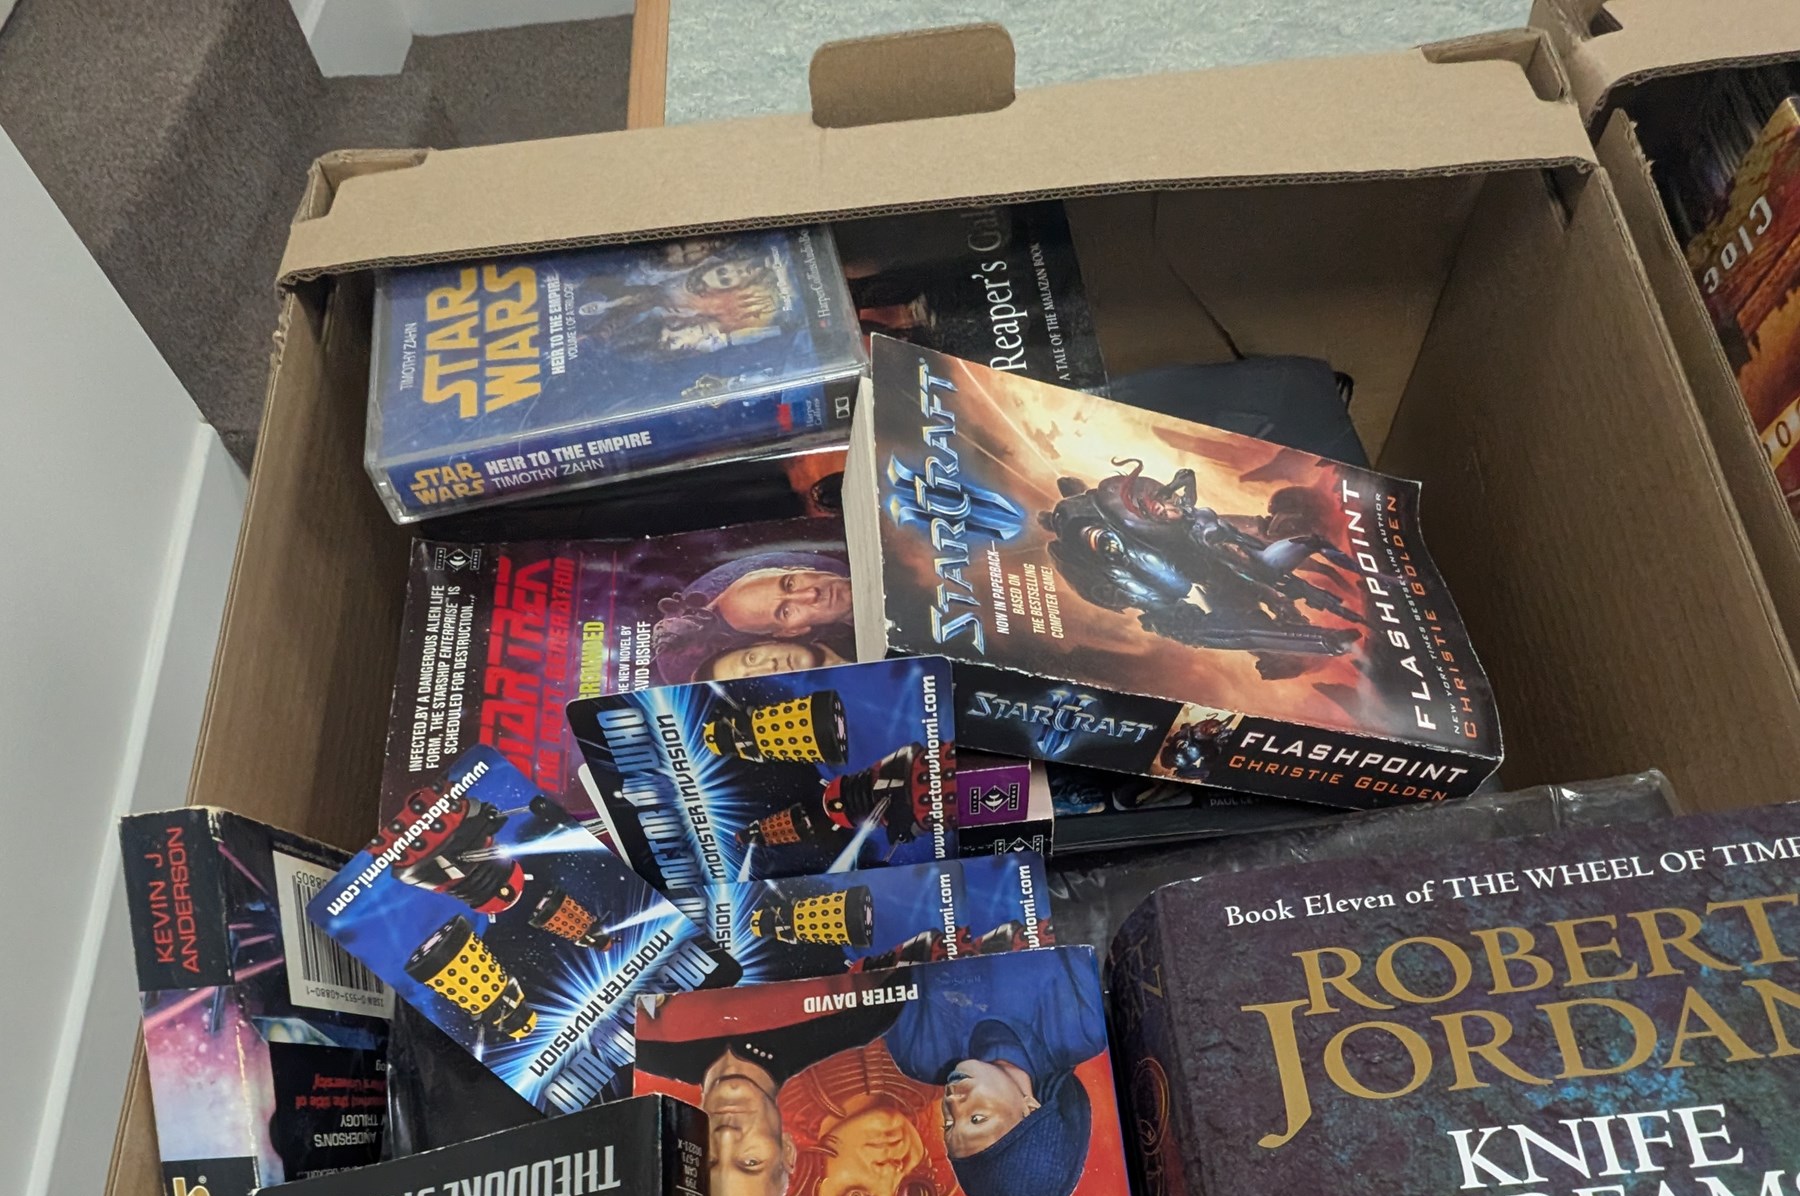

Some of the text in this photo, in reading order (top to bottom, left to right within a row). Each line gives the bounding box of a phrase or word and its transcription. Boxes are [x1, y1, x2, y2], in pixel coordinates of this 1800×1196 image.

[421, 267, 481, 420] STAR
[482, 264, 542, 415] WARS
[549, 312, 567, 376] HEIR TO THE
[971, 261, 1028, 371] Reaper's
[1045, 312, 1060, 332] THE
[1049, 333, 1063, 346] OF
[408, 463, 482, 492] STAR
[484, 430, 652, 474] HEIR TO THE EMPIRE
[491, 458, 605, 491] TIMOTHY ZAHN
[412, 478, 486, 506] WARS
[448, 585, 461, 595] IS
[487, 555, 551, 665] TREK
[544, 556, 576, 682] GENERATION
[995, 612, 1010, 634] NOW
[1007, 573, 1025, 615] BASED ON
[1023, 563, 1046, 633] THE BESTSELLING
[1040, 566, 1064, 638] COMPUTER GAME!
[1342, 480, 1437, 730] FLASHPOINT
[1376, 493, 1460, 734] NEW YORK TIMES BESTSELLING AUTHOR
[1387, 495, 1478, 739] CHRISTIE GOLDEN
[578, 621, 605, 700] ROUNDED
[619, 625, 632, 681] NEW NOVEL BY
[636, 620, 652, 665] BISHOFF
[409, 584, 445, 772] INFECTED DANGEROUS ALIEN LIFE
[433, 661, 450, 710] STARSHIP
[451, 668, 466, 692] FOR
[430, 710, 445, 732] THE
[444, 694, 464, 754] SCHEDULED
[596, 707, 660, 773] WHO
[657, 713, 702, 803] INVASION
[922, 674, 945, 859] www.doctorwhomi.com
[1228, 754, 1447, 801] CHRISTIE GOLDEN
[1239, 732, 1469, 784] FLASHPOINT
[326, 760, 489, 917] www.doctorwhomi.com
[687, 803, 726, 880] MONSTER
[166, 826, 200, 973] ANDERSON
[1224, 900, 1296, 928] Book
[1303, 890, 1396, 920] Eleven
[1405, 880, 1435, 905] of
[1443, 872, 1520, 901] THE
[1521, 856, 1654, 892] WHEEL
[1658, 848, 1707, 874] OF
[149, 880, 176, 963] KEVIN
[1292, 893, 1799, 1017] ROBERT
[528, 929, 674, 1079] MONSTER INVASION
[803, 983, 920, 1015] PETER DAVID
[543, 1049, 616, 1115] WHO
[313, 1131, 377, 1149] ANDERSON'S
[340, 1114, 378, 1128] TRILOGY
[1447, 1103, 1745, 1190] KNIFE
